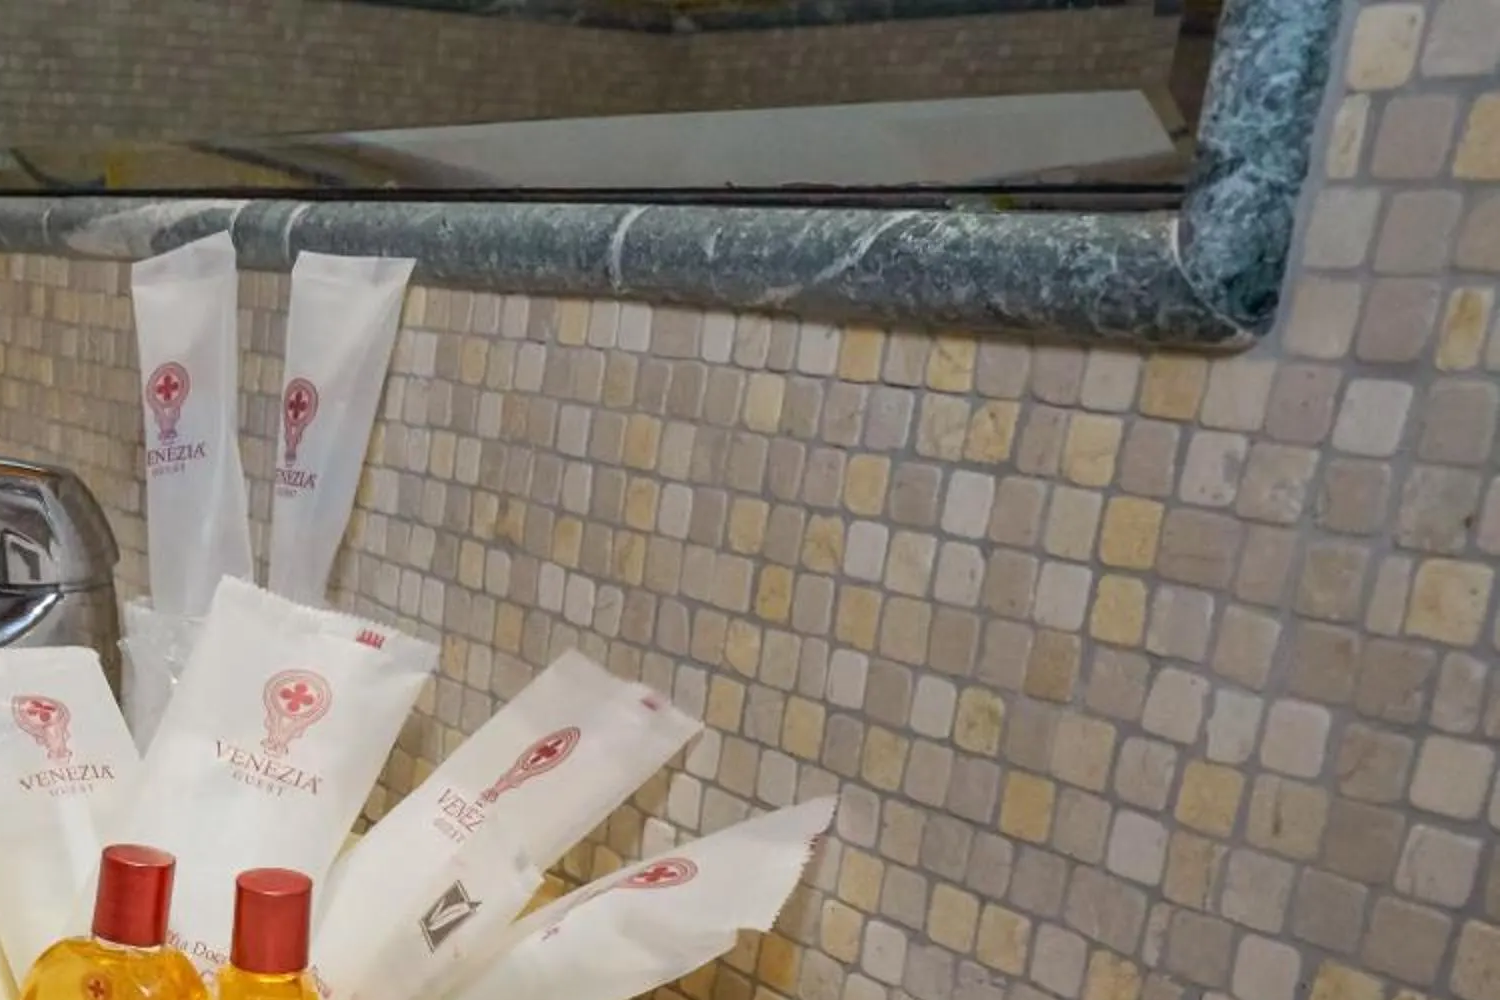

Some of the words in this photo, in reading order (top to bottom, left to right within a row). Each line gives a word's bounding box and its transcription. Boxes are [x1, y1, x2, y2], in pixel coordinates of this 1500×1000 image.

[147, 440, 205, 466] ENEZIA
[18, 764, 115, 790] VENEZIA
[215, 738, 322, 795] VENEZIA
